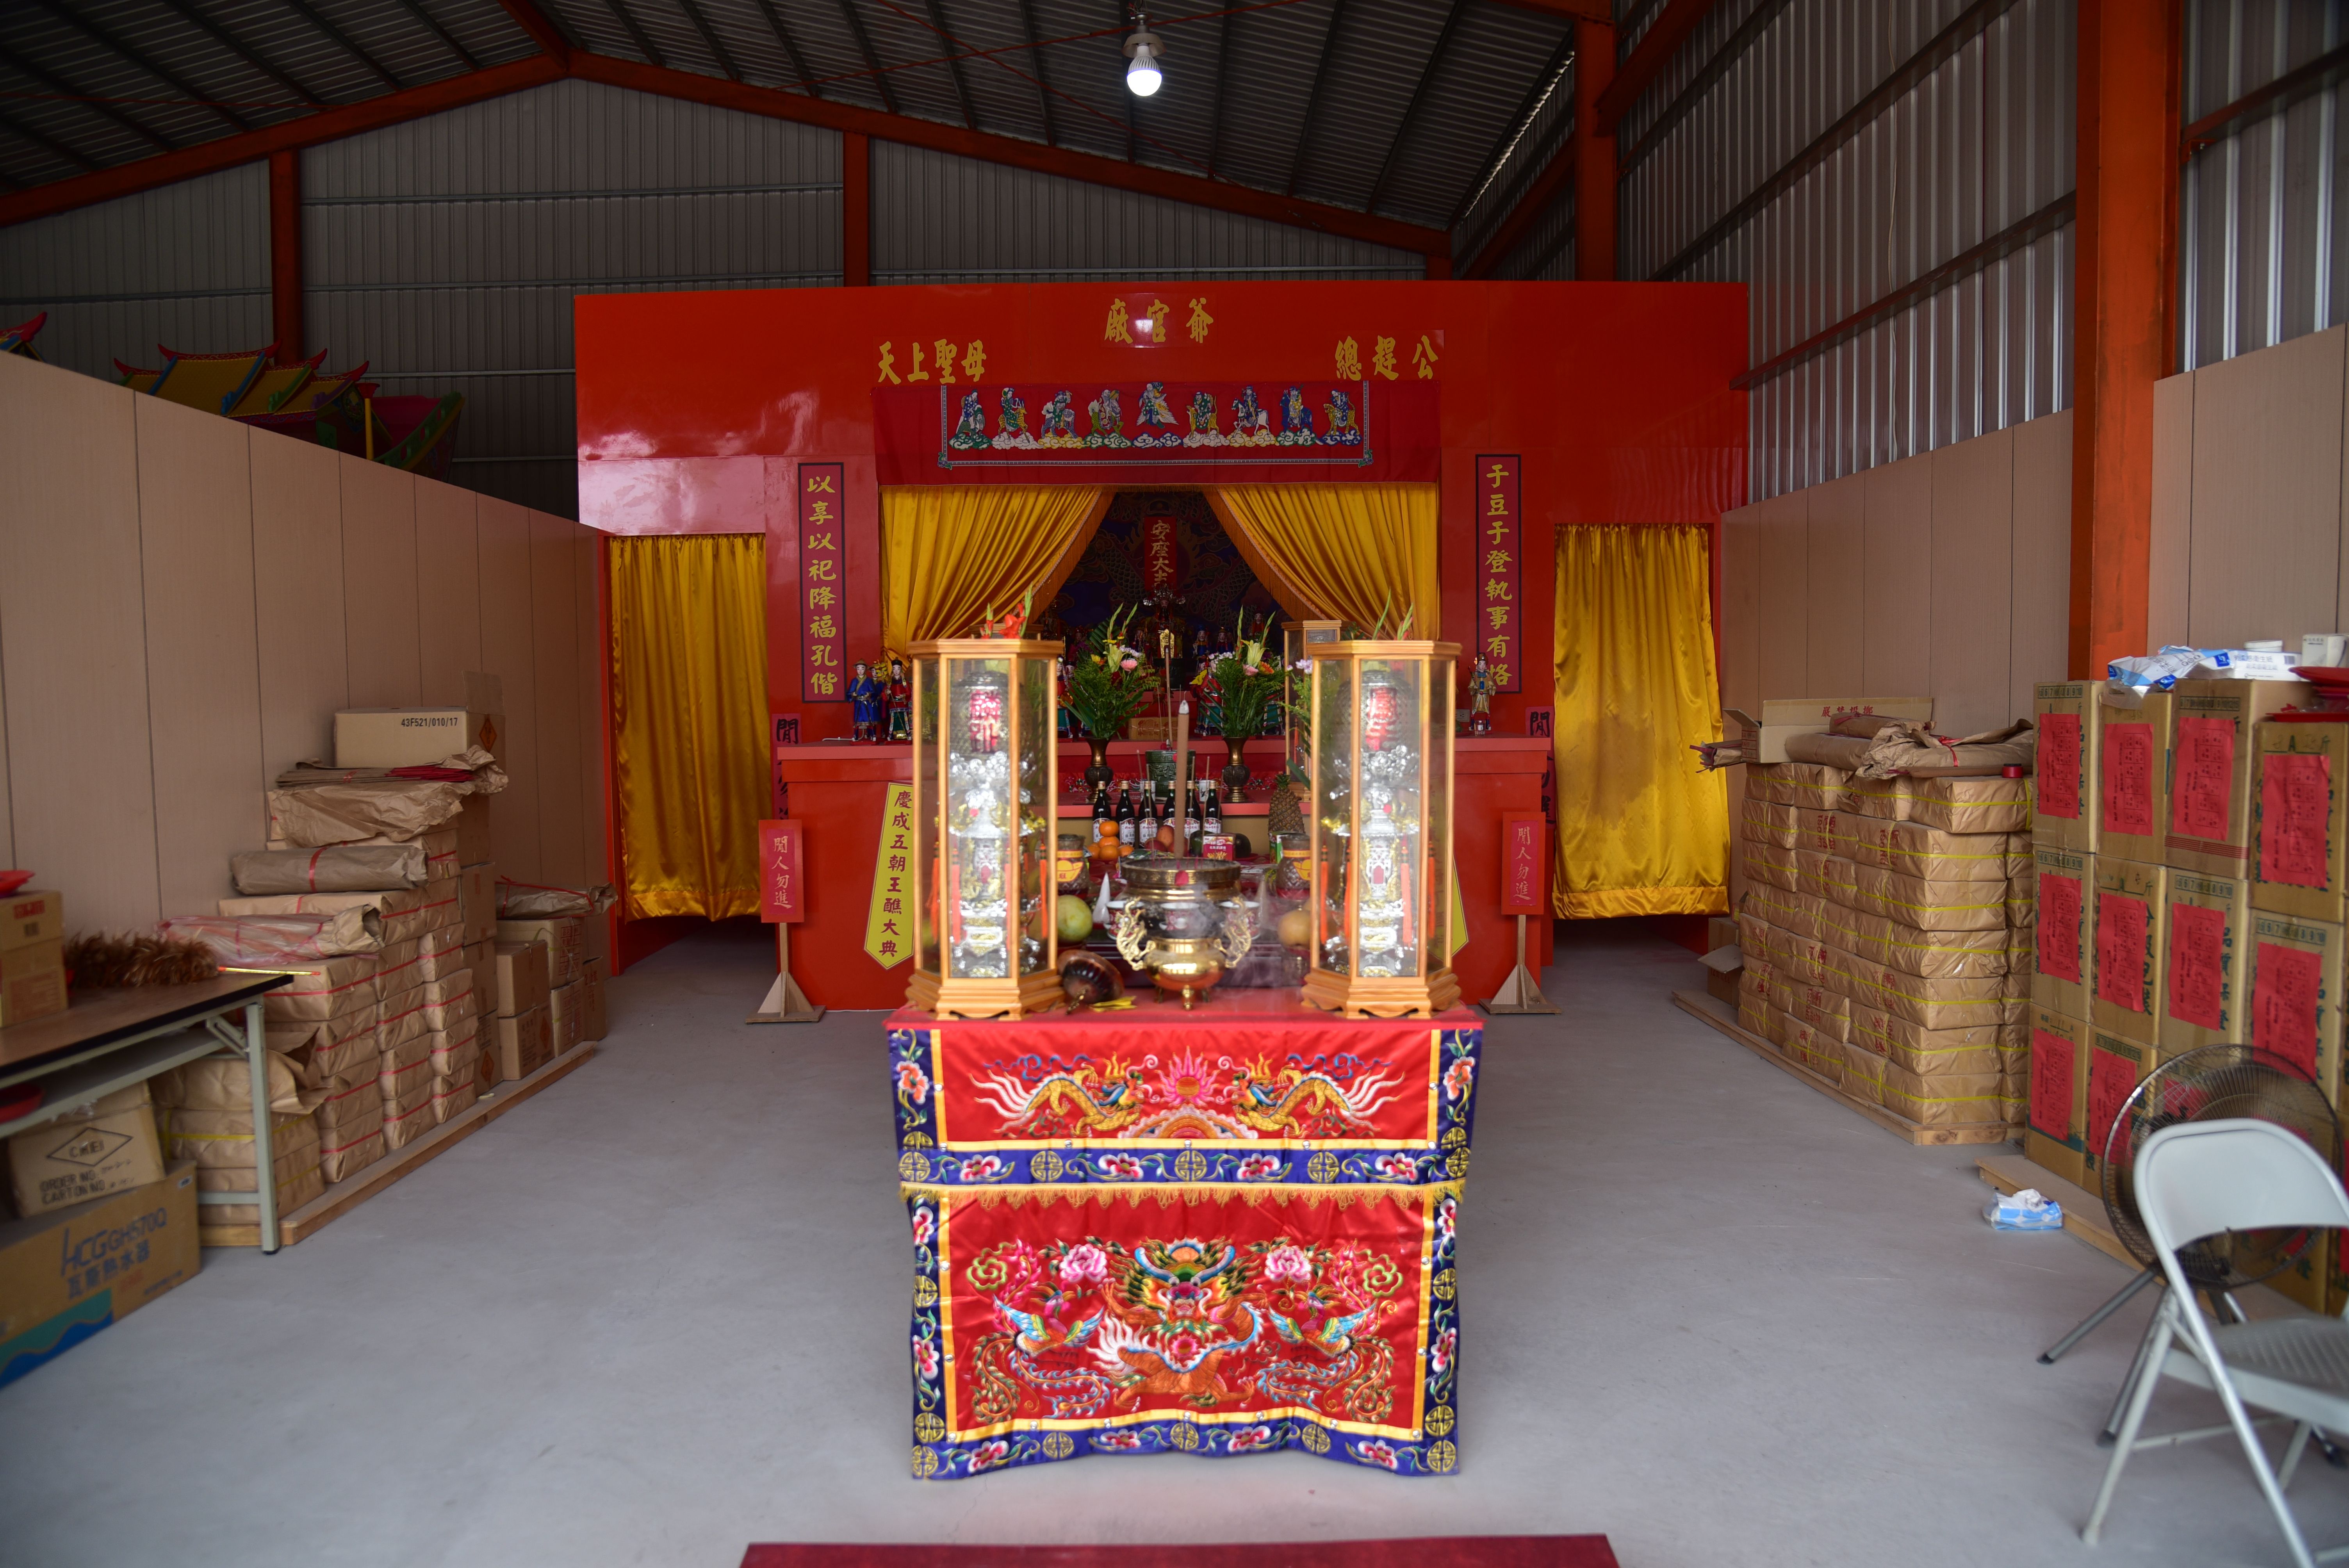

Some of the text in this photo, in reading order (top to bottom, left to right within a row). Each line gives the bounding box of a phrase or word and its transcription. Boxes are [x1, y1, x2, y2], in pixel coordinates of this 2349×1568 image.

[1104, 297, 1214, 344] 廠官爺
[877, 339, 987, 385] 天上聖母
[807, 475, 838, 695] 以享以祀降福孔偕
[1485, 464, 1513, 686] 于豆于登執事有恪
[401, 717, 458, 727] 43F521/010/17
[771, 836, 793, 909] 閒人勿進
[879, 790, 912, 957] 慶成五朝王醮大典
[1513, 825, 1532, 900] 閒人勿進
